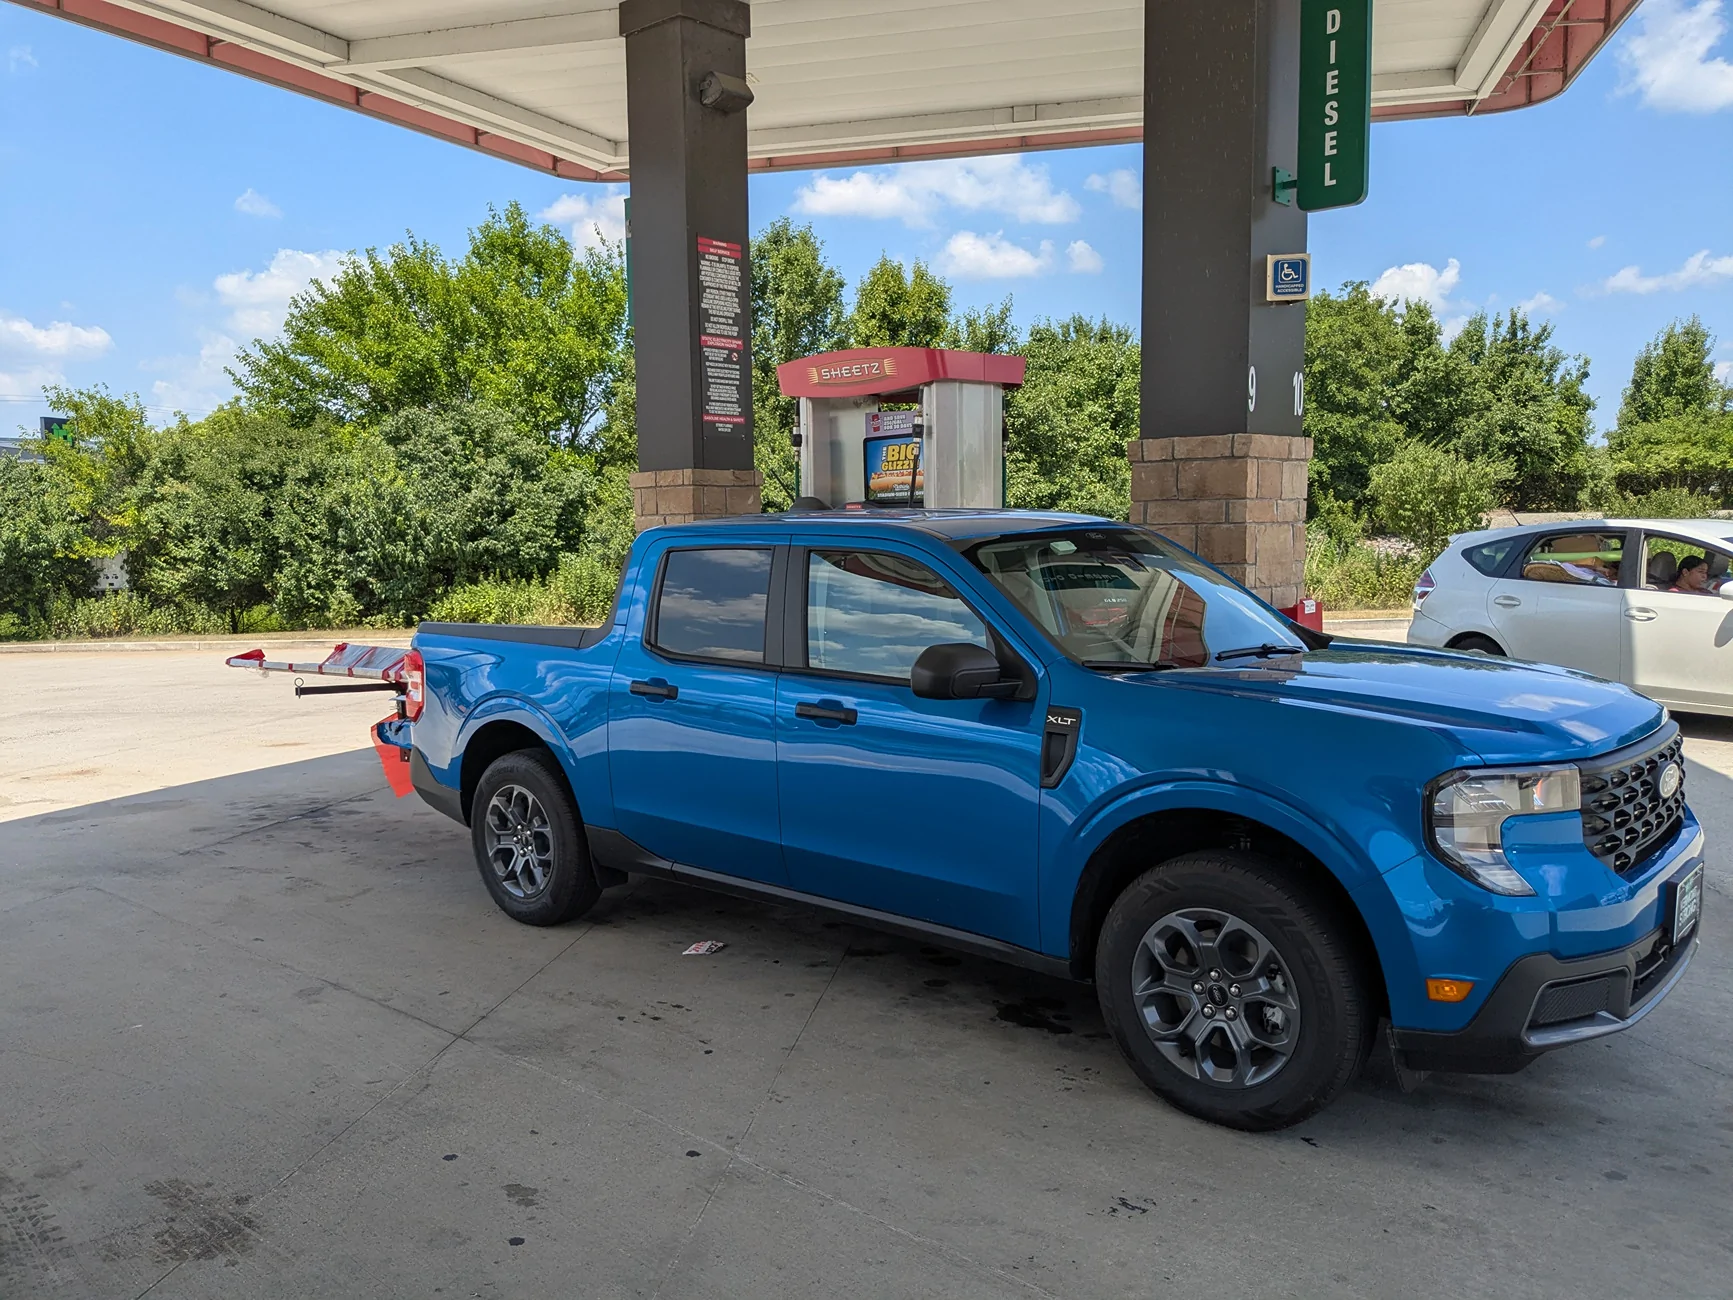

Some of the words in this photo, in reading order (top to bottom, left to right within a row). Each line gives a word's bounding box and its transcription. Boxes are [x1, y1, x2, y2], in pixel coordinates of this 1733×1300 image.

[1324, 9, 1341, 187] DIESEL
[821, 362, 880, 379] SHEETZ
[1248, 365, 1256, 412] 9
[1292, 371, 1304, 416] 10
[1046, 715, 1076, 725] XLT
